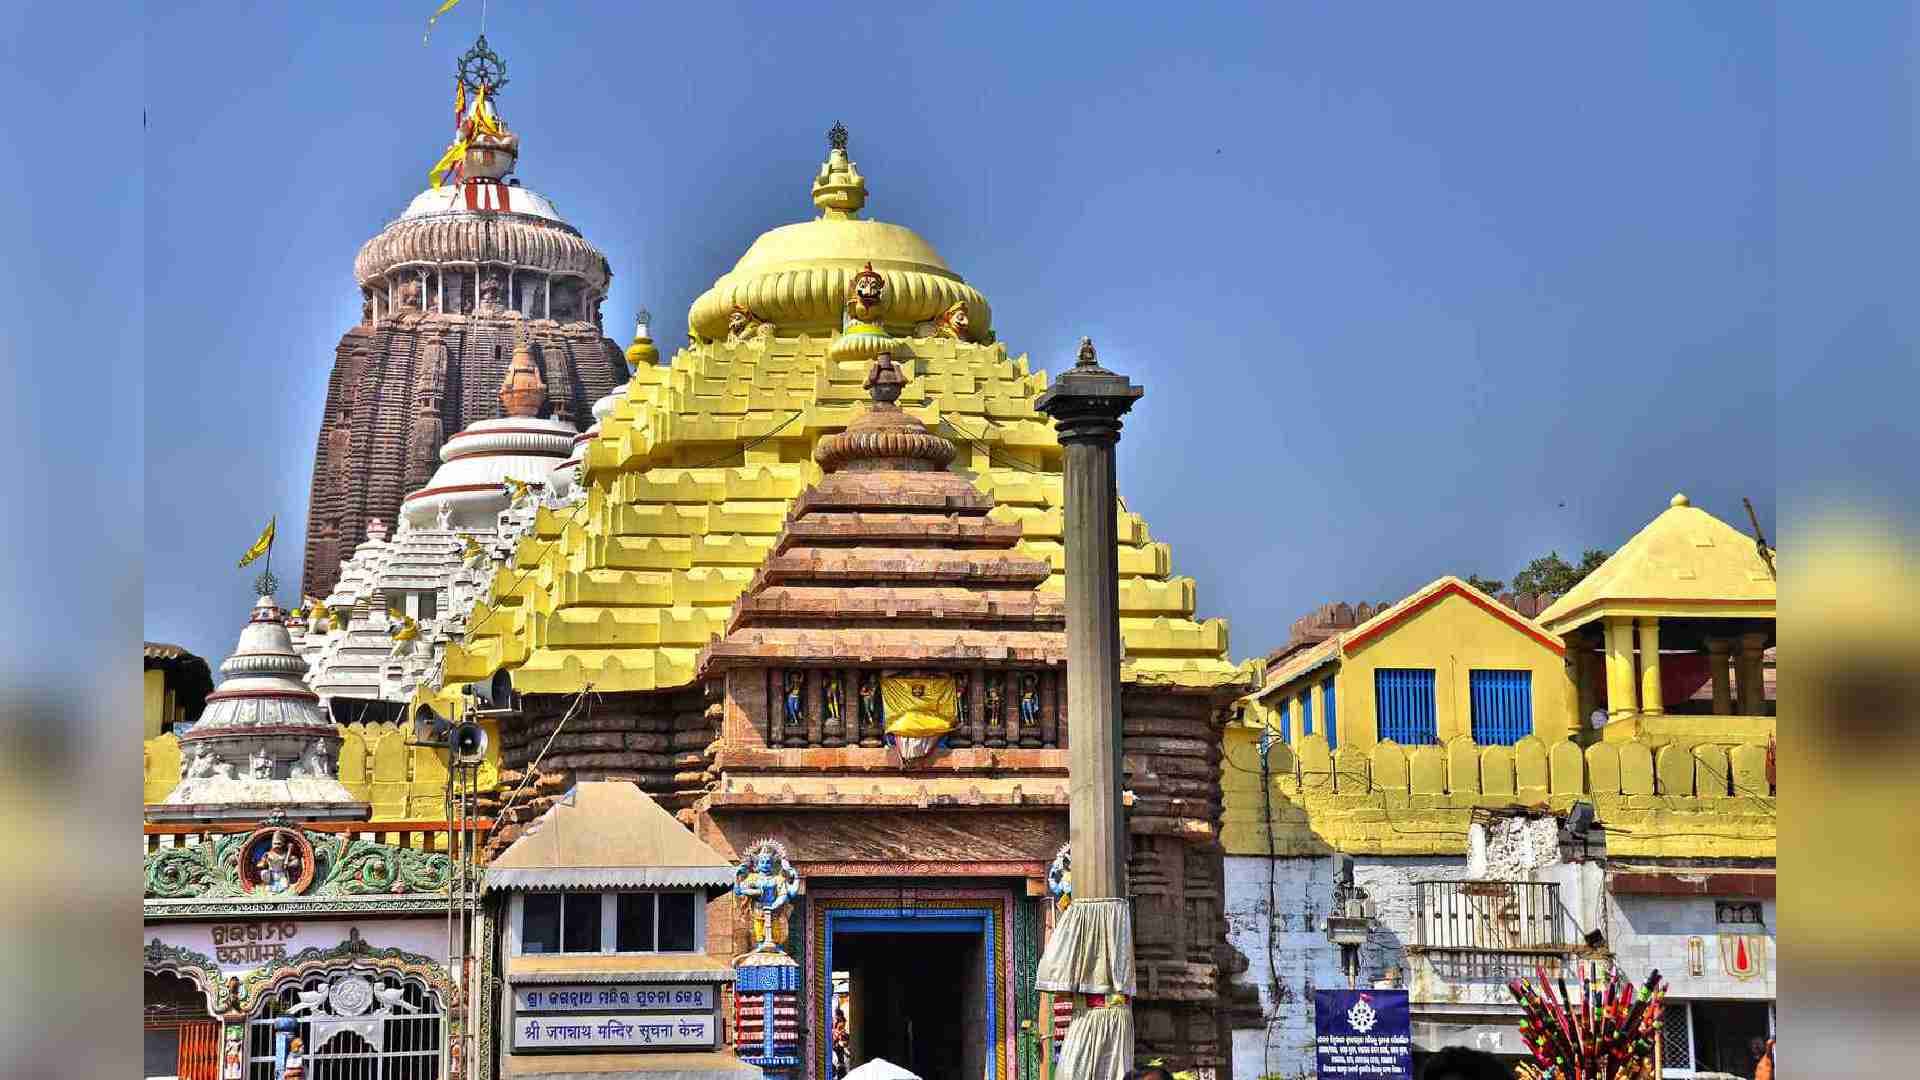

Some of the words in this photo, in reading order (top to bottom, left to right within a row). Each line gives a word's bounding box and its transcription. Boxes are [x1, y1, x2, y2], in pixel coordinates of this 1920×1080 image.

[525, 1020, 540, 1040] श्री
[545, 1025, 592, 1041] जगन्नाथ
[597, 1019, 634, 1041] मन्दिर
[637, 1024, 673, 1043] सूचना
[677, 1018, 704, 1040] केन्द्र
